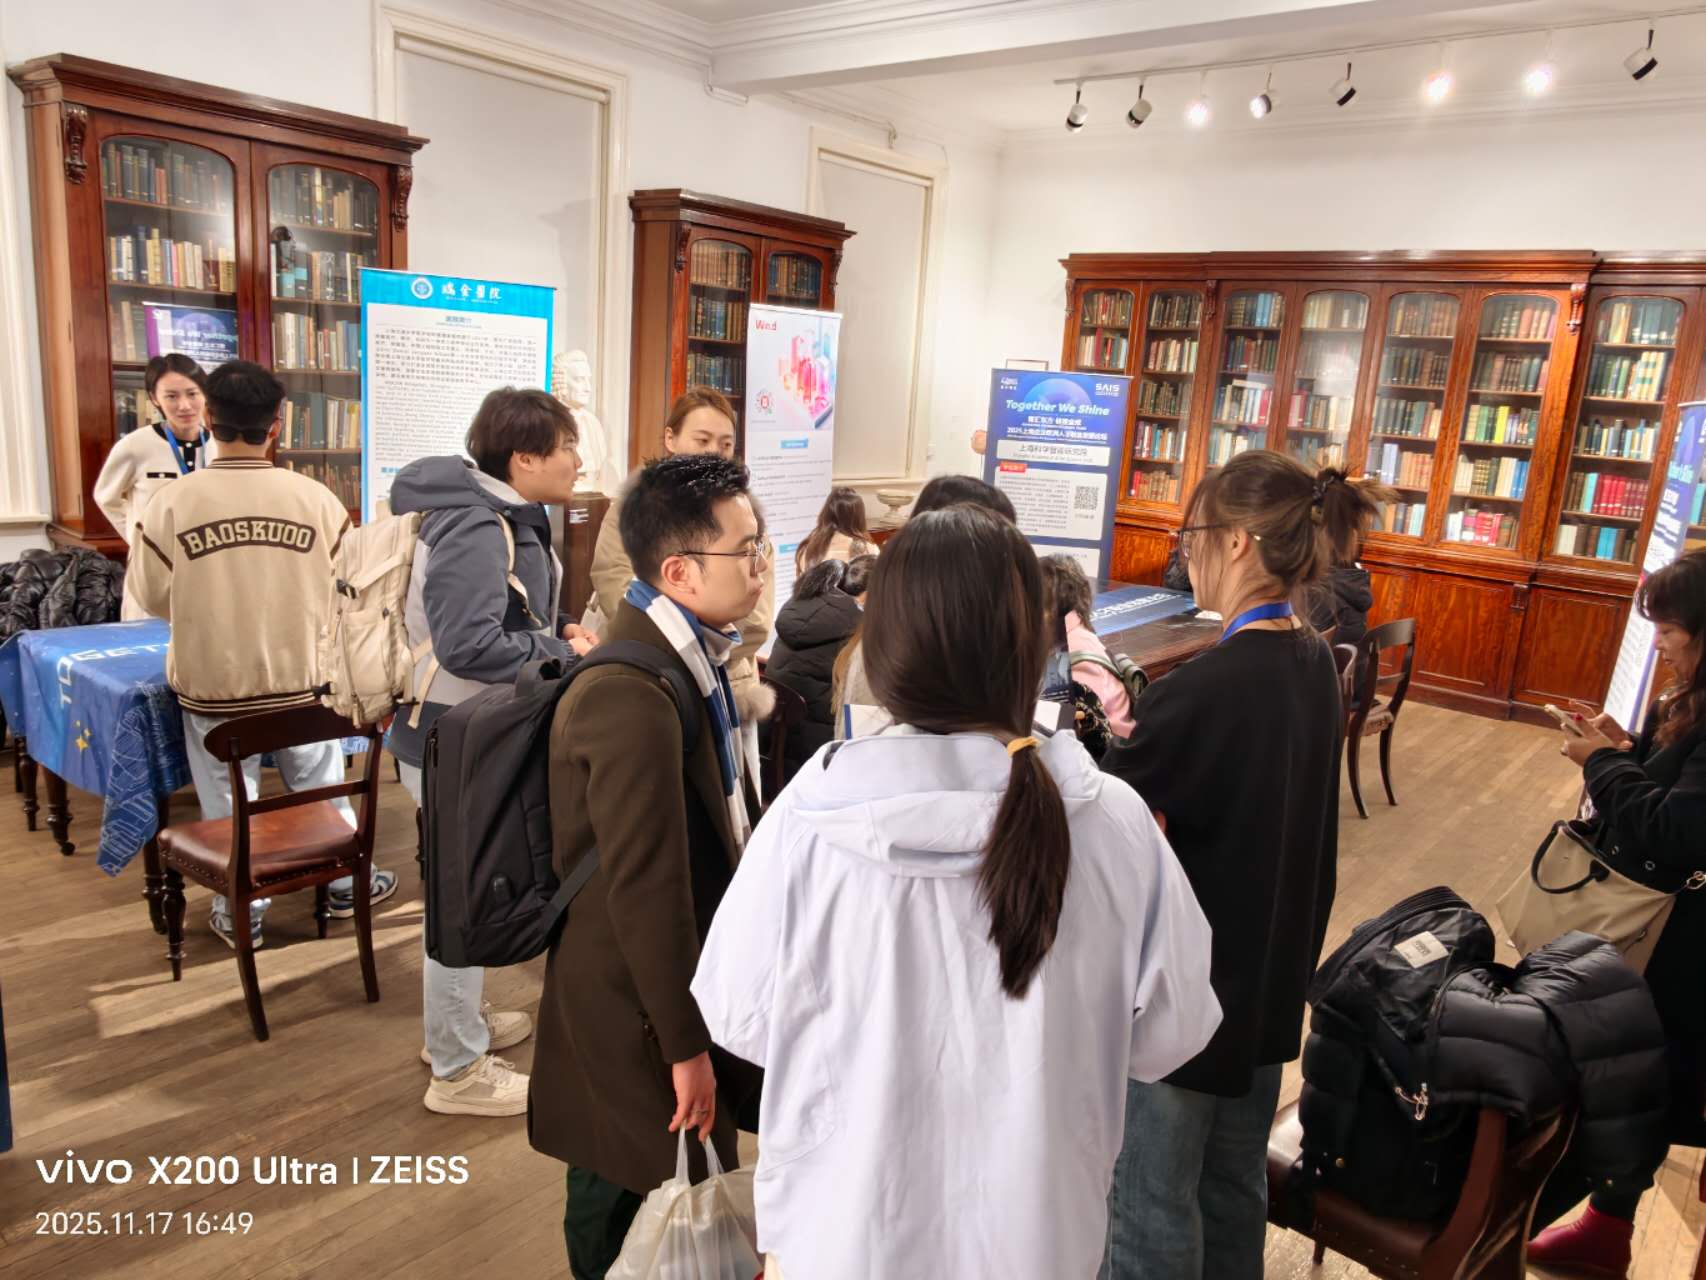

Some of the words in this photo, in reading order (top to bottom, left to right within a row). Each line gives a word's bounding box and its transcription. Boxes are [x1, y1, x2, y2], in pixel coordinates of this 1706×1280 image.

[1095, 383, 1120, 392] SAIS
[1005, 399, 1057, 412] Together
[1058, 402, 1076, 413] We
[1078, 404, 1110, 416] Shine
[184, 520, 312, 554] BAOSKUOO
